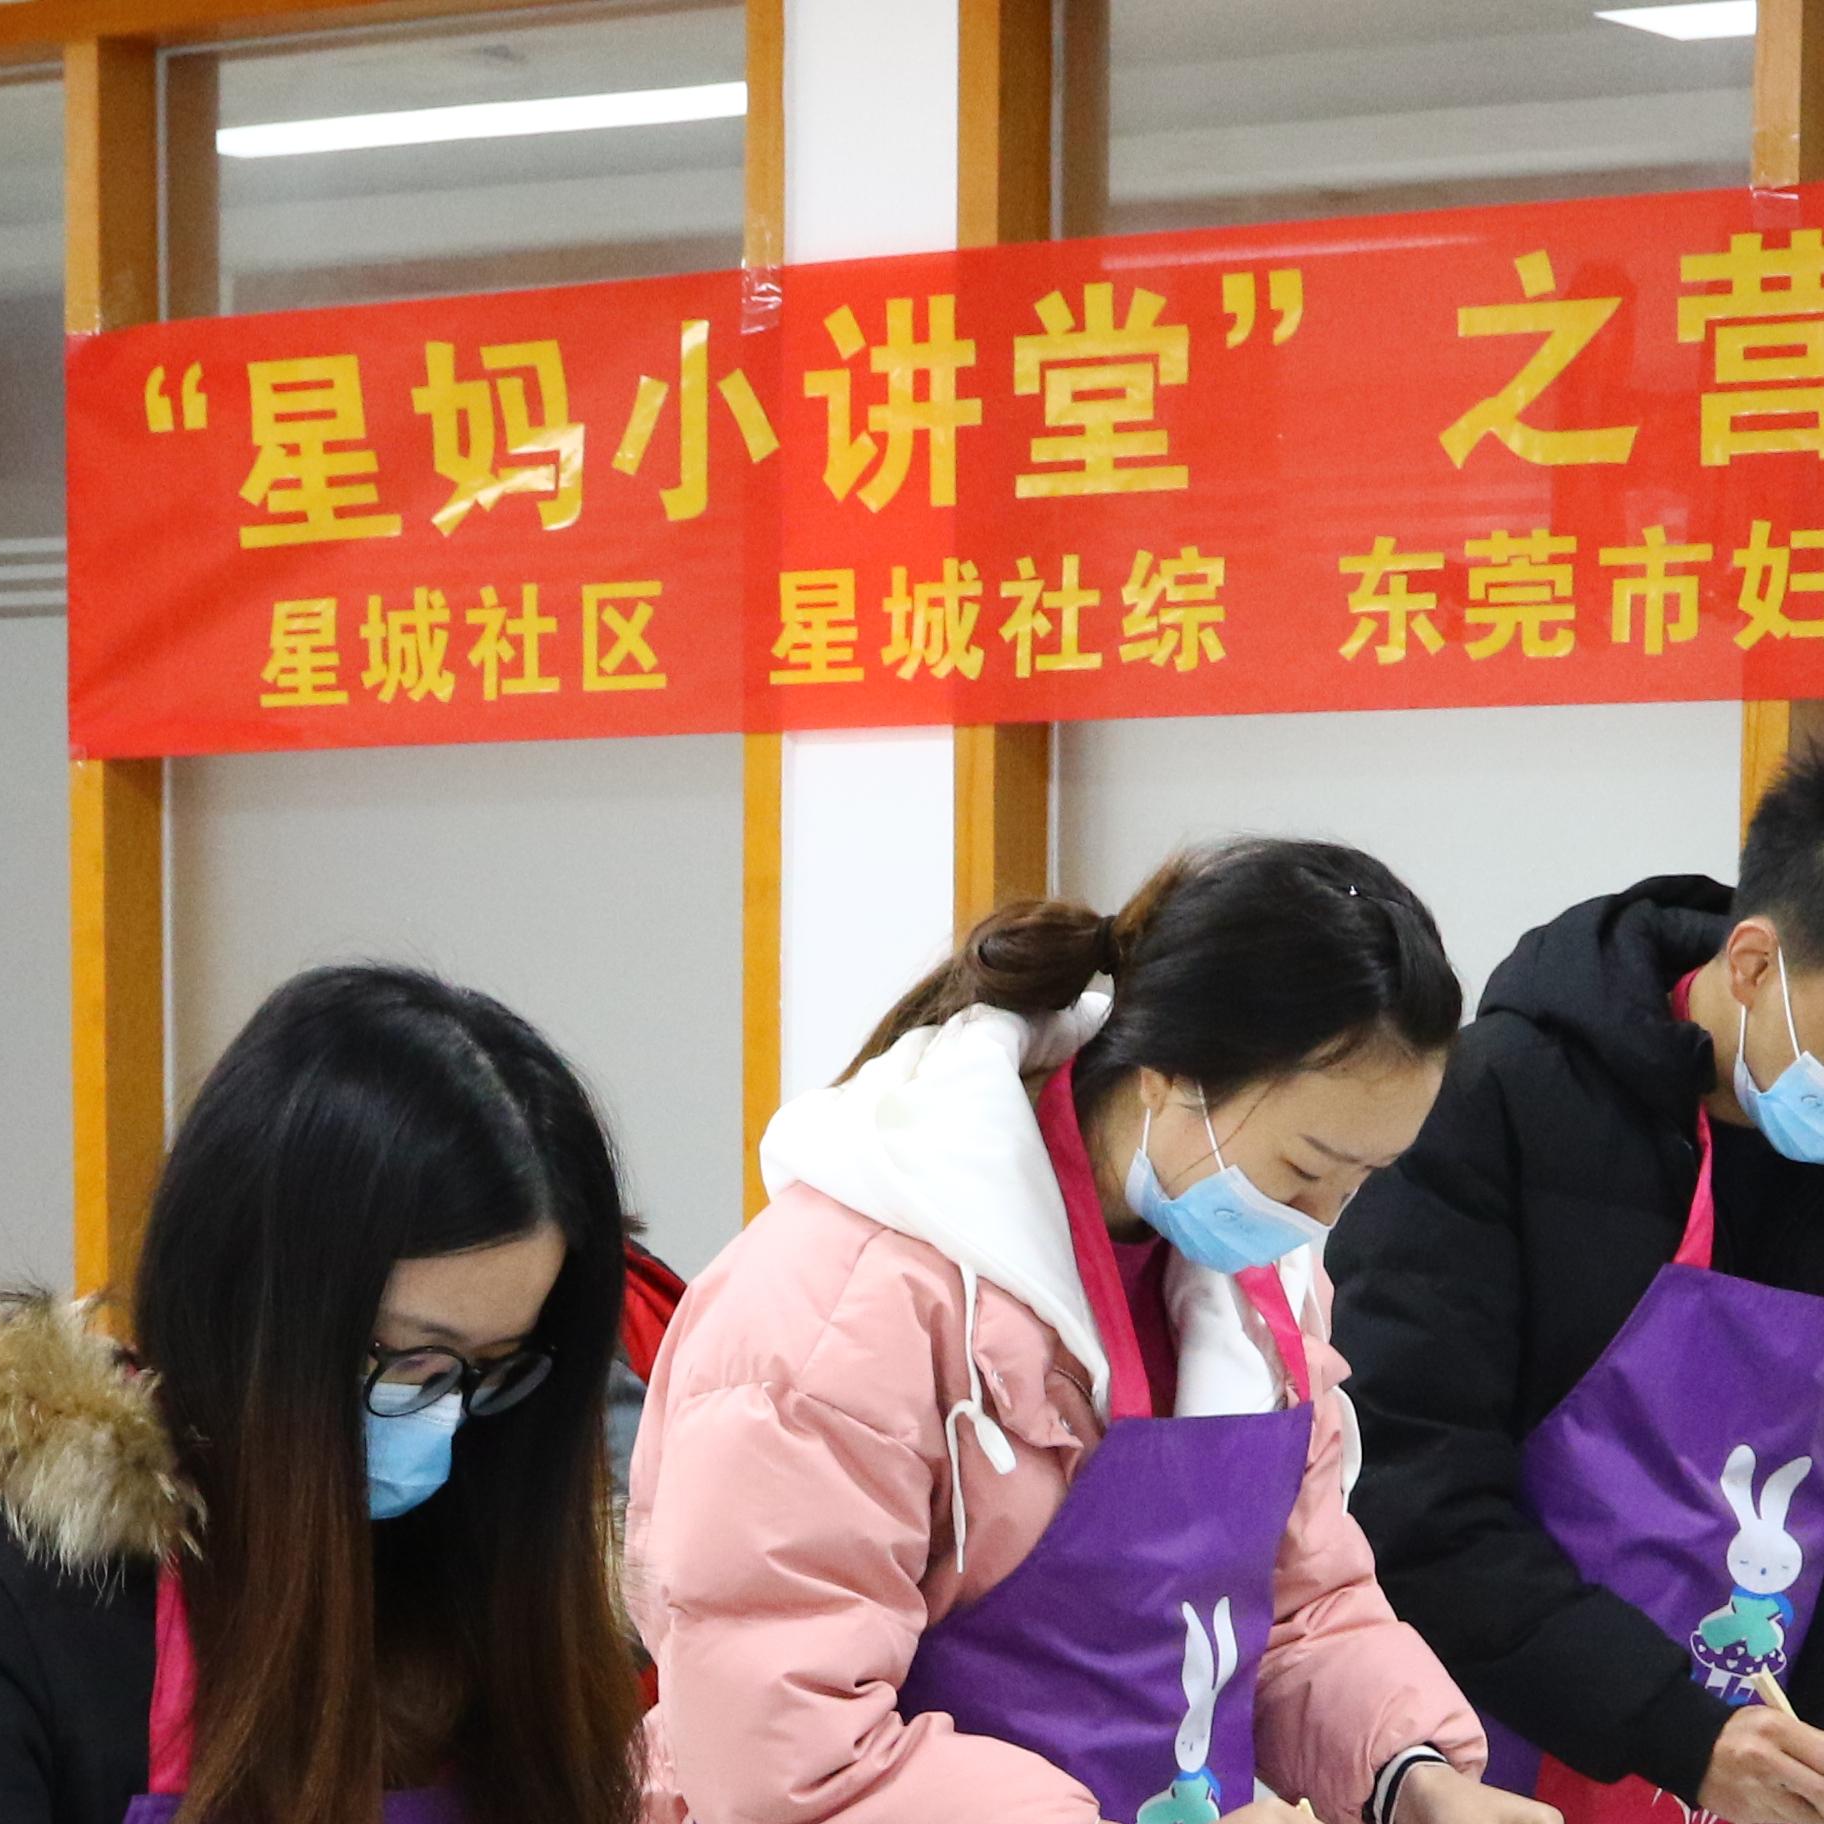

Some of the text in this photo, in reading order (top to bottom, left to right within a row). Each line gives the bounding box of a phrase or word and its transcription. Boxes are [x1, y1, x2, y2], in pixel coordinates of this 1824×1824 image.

[144, 268, 1304, 549] “星妈小讲堂”
[260, 580, 668, 708] 星城社区
[769, 545, 1228, 685] 星城社综
